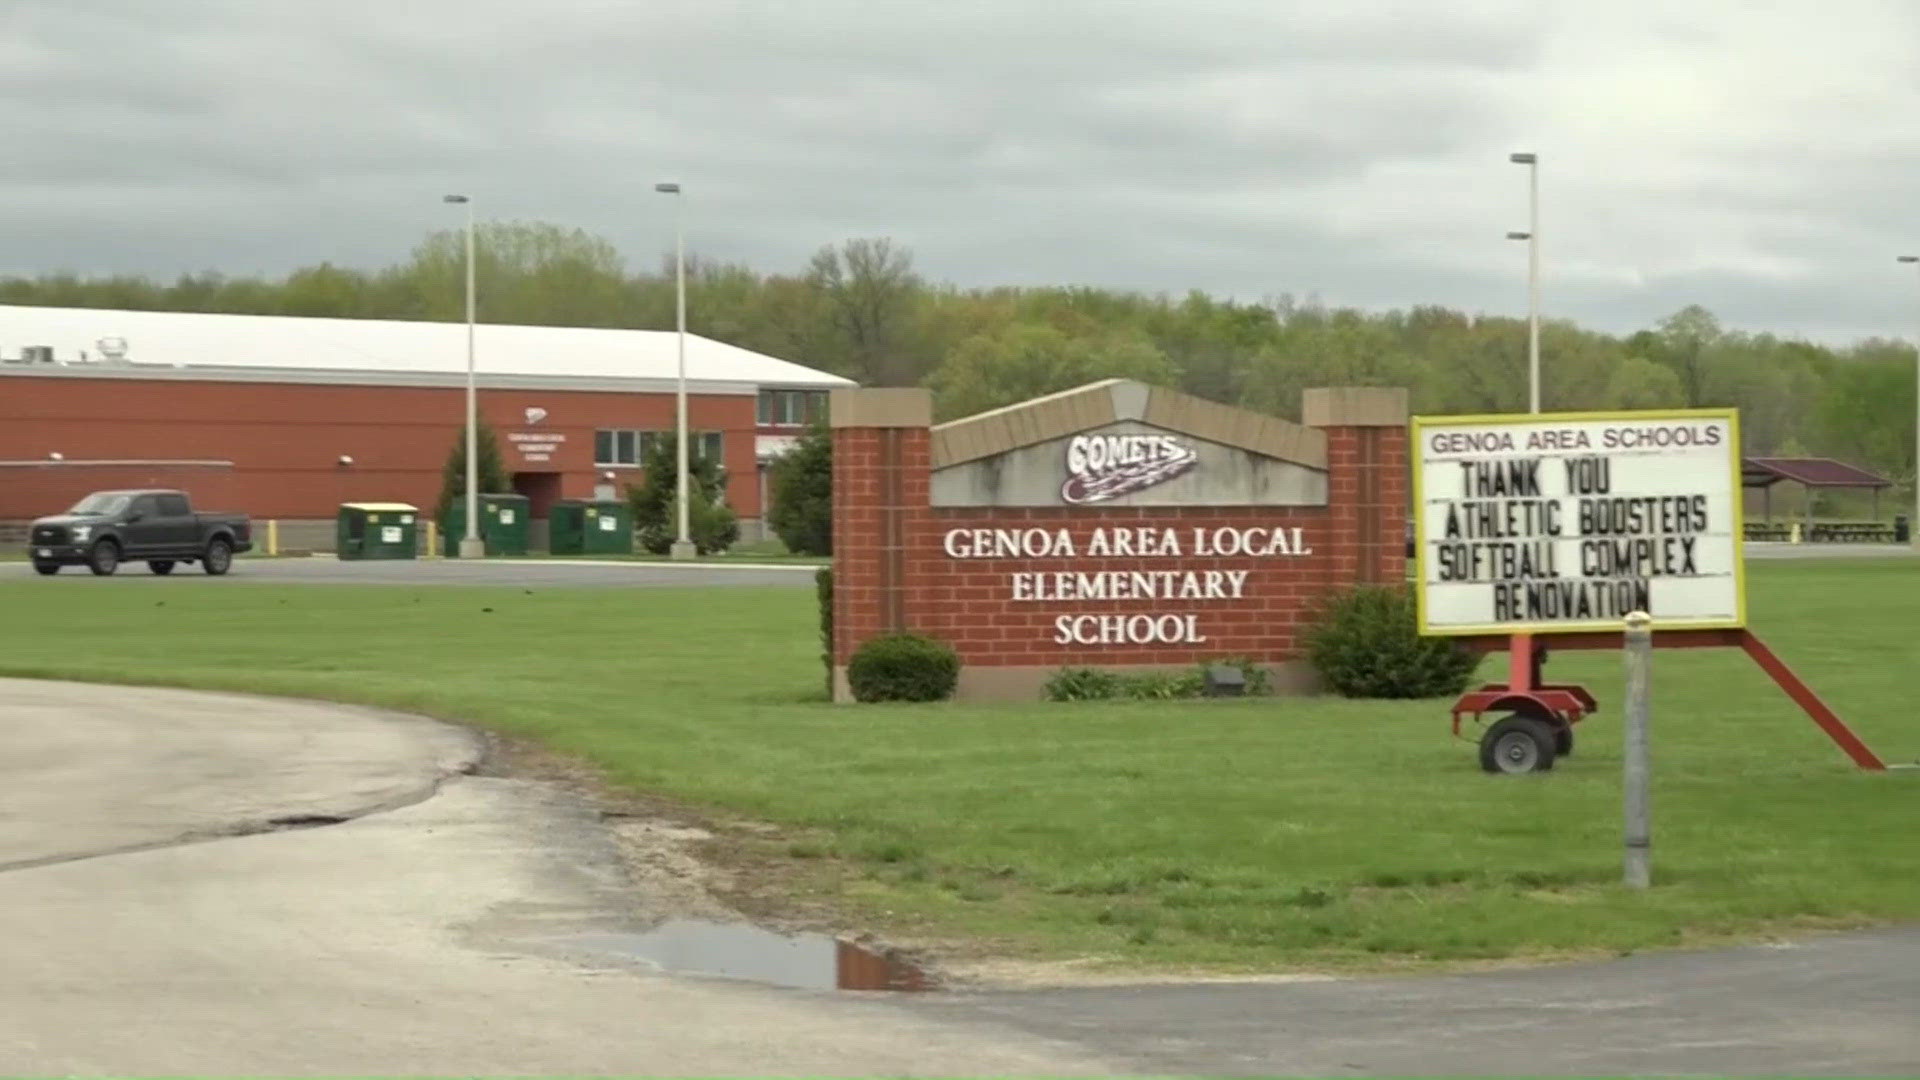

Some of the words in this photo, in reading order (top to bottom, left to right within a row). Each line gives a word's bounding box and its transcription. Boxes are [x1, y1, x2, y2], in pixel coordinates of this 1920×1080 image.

[1066, 434, 1178, 474] COMETS
[1431, 432, 1514, 453] GENOA
[1526, 429, 1590, 449] AREA
[1603, 425, 1721, 448] SCHOOLS
[1460, 460, 1541, 498] THANK
[1564, 457, 1610, 495] YOU
[1445, 499, 1562, 538] ATHLETIC
[1578, 495, 1708, 535] BOOSTERS
[944, 528, 1076, 557] GENOA
[1088, 527, 1182, 556] AREA
[1195, 527, 1312, 556] LOCAL
[1438, 541, 1560, 580] SOFTBALL
[1581, 537, 1697, 577] COMPLEX
[1012, 570, 1246, 599] ELEMENTARY
[1495, 580, 1651, 621] RENOVATION
[1054, 614, 1205, 643] SCHOOL
